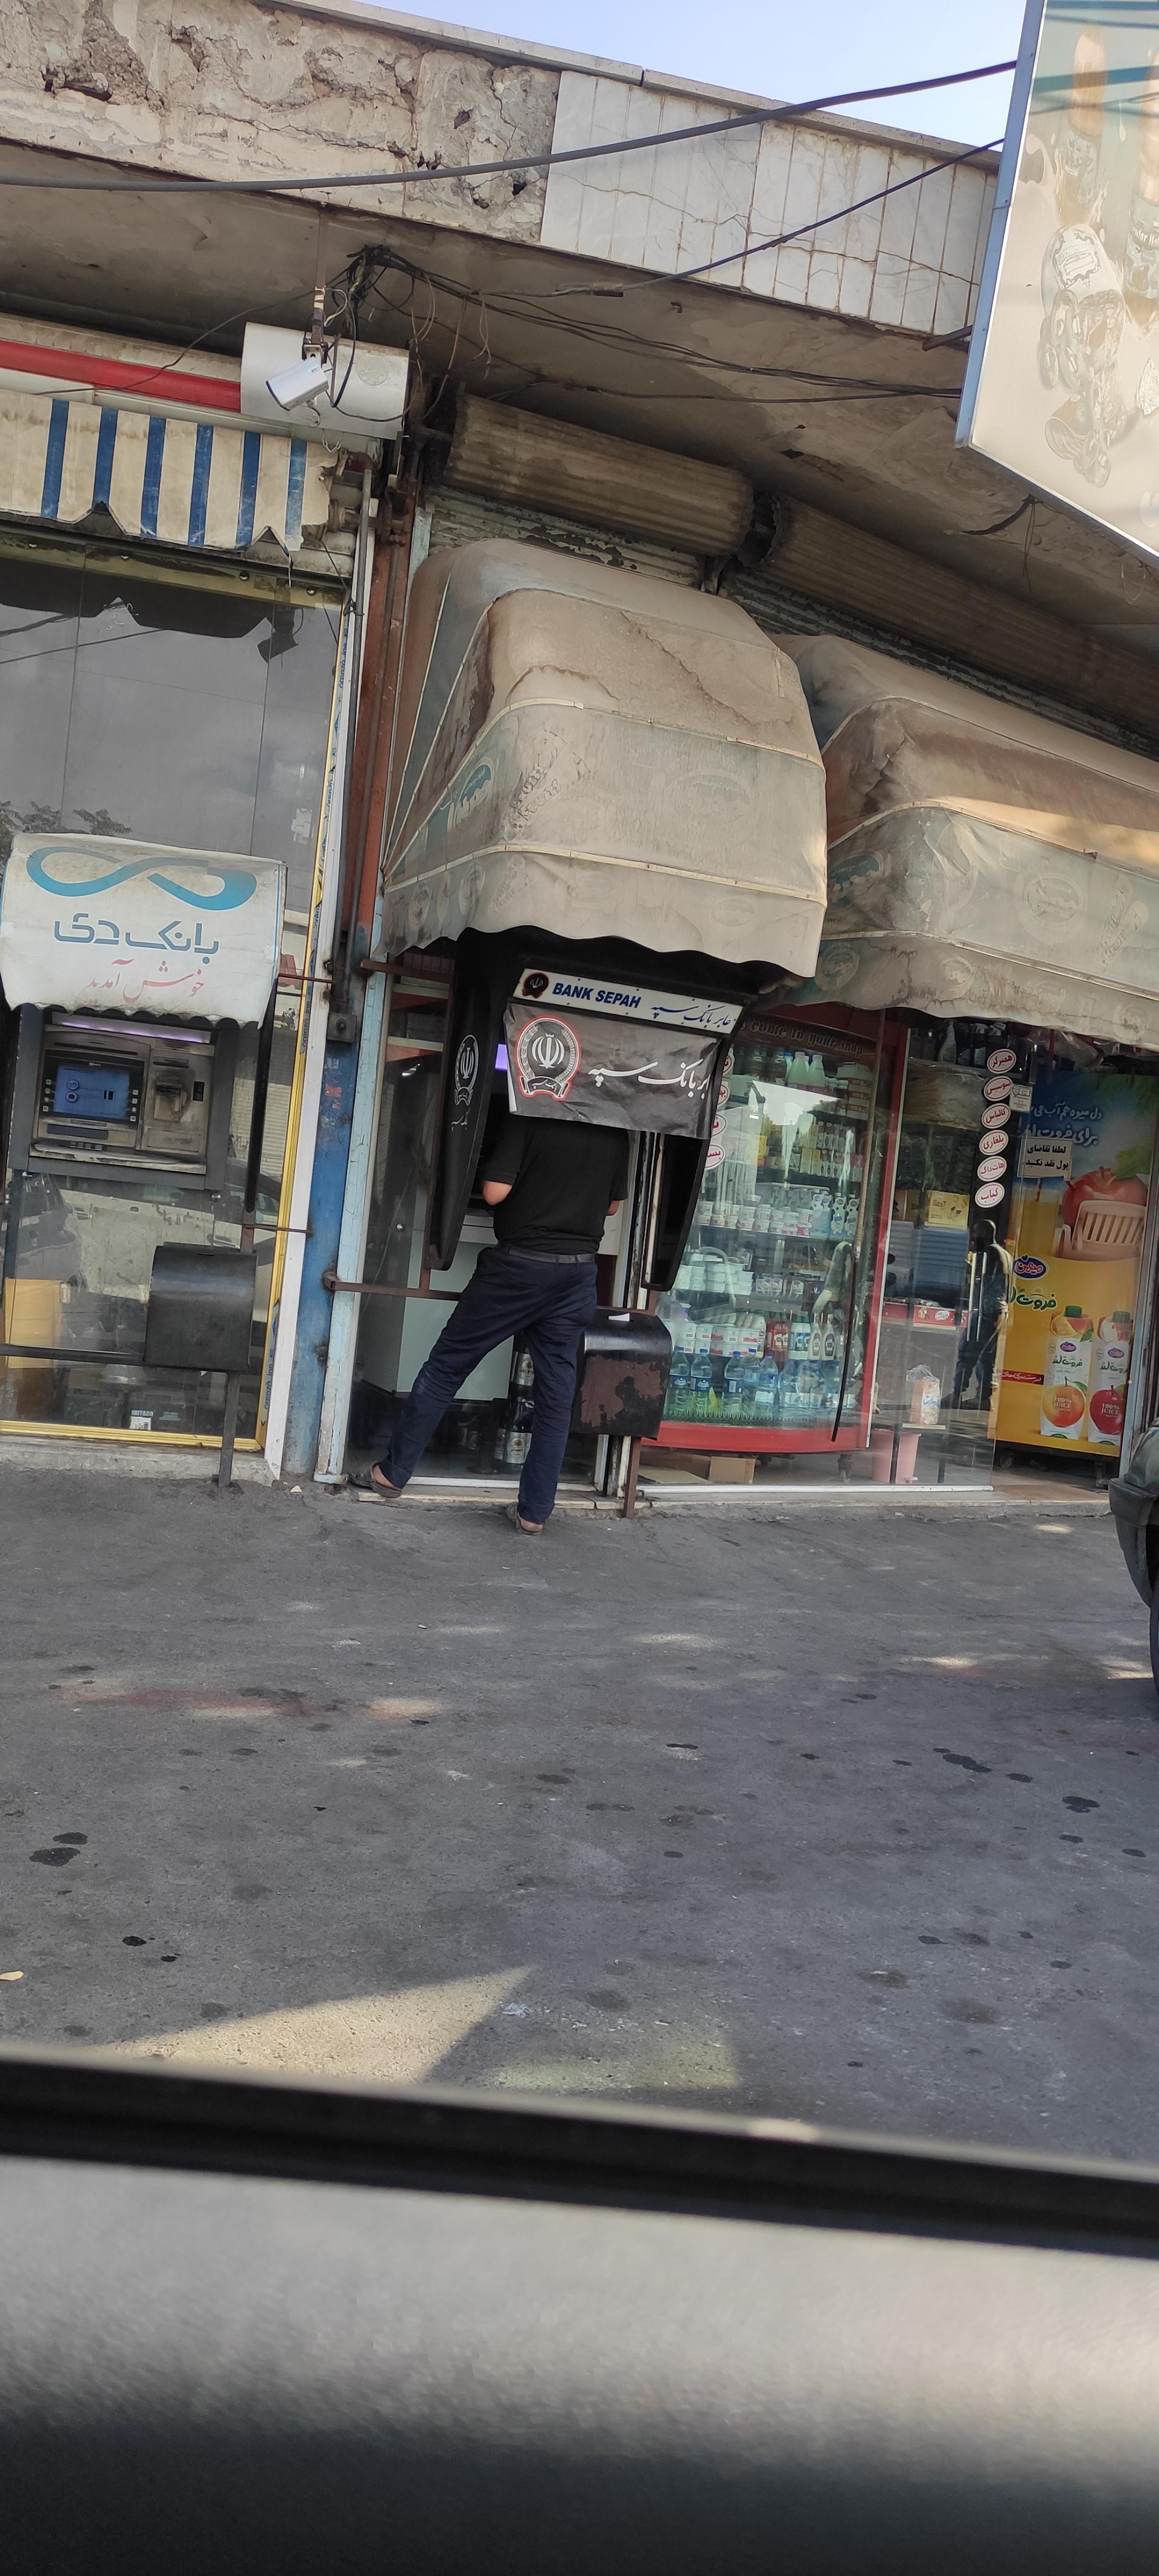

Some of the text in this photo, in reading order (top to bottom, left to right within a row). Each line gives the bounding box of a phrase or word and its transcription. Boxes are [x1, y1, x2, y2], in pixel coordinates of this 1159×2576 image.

[54, 913, 220, 965] بانک دی
[84, 958, 205, 1005] خوش آمدید
[552, 982, 642, 1009] BANK SEPAH
[650, 1004, 700, 1019] سپه
[683, 1004, 726, 1028] بانک
[713, 1015, 731, 1028] عابر
[992, 1055, 1013, 1068] همبرگر
[588, 1061, 658, 1088] سپه
[637, 1058, 704, 1098] بانک
[700, 1073, 711, 1099] ابر
[986, 1082, 1011, 1095] سوسیس
[986, 1108, 1006, 1124] کالباس
[983, 1135, 1004, 1150] بلغاری
[1027, 1144, 1067, 1154] لطفا تقاضای
[1025, 1158, 1043, 1168] نکنید
[1044, 1159, 1055, 1167] نقد
[980, 1187, 998, 1203] کباب
[1015, 1261, 1044, 1275] میهن
[1016, 1292, 1058, 1310] فروت
